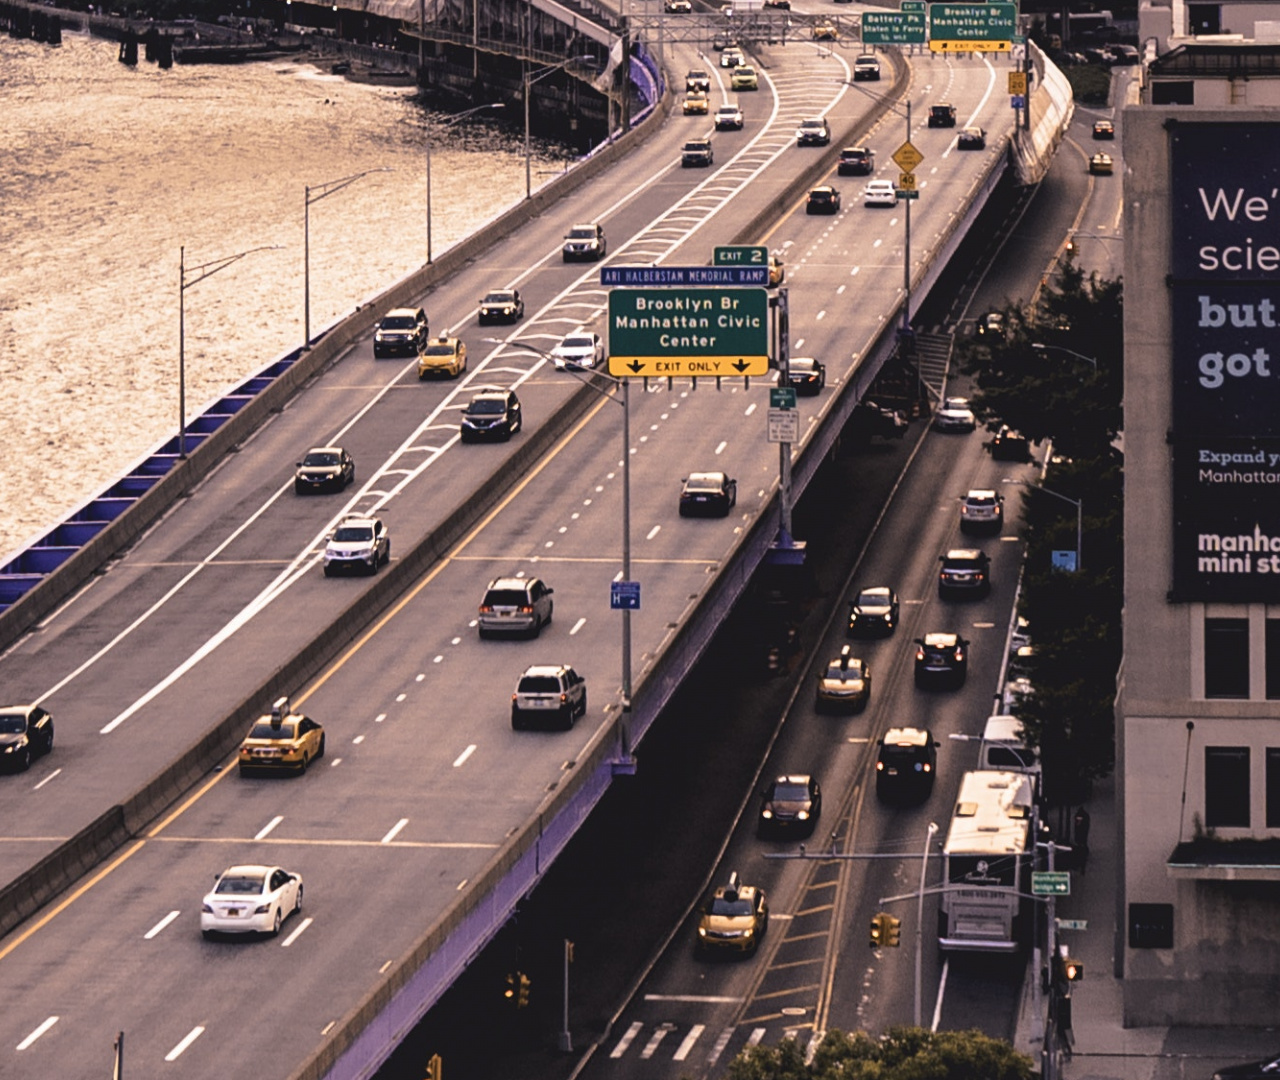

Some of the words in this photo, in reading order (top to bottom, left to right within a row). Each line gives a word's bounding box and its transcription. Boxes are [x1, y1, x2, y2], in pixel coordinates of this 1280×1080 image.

[944, 7, 987, 17] Brooklyn
[990, 7, 1001, 16] Br
[867, 14, 903, 24] Battery
[907, 15, 919, 23] Pk
[933, 18, 985, 26] Manhattan
[988, 18, 1013, 26] Civic
[863, 25, 889, 33] Staten
[902, 25, 924, 34] Ferry
[956, 28, 989, 36] Center
[902, 176, 915, 184] 40
[719, 251, 742, 261] EXIT
[750, 250, 763, 262] 2
[605, 271, 621, 282] ARI
[625, 271, 684, 282] HALBERSTAM
[689, 271, 734, 282] MEMORIAL
[739, 271, 765, 282] RAMP
[636, 297, 713, 312] Brooklyn
[721, 297, 739, 310] Br
[1198, 296, 1275, 327] but
[615, 315, 709, 329] Manhattan
[717, 315, 761, 328] Civic
[659, 334, 717, 347] Center
[655, 362, 682, 371] EXIT
[688, 361, 721, 371] ONLY
[1198, 347, 1271, 389] got
[1198, 450, 1265, 463] Expand
[1198, 553, 1252, 573] mini
